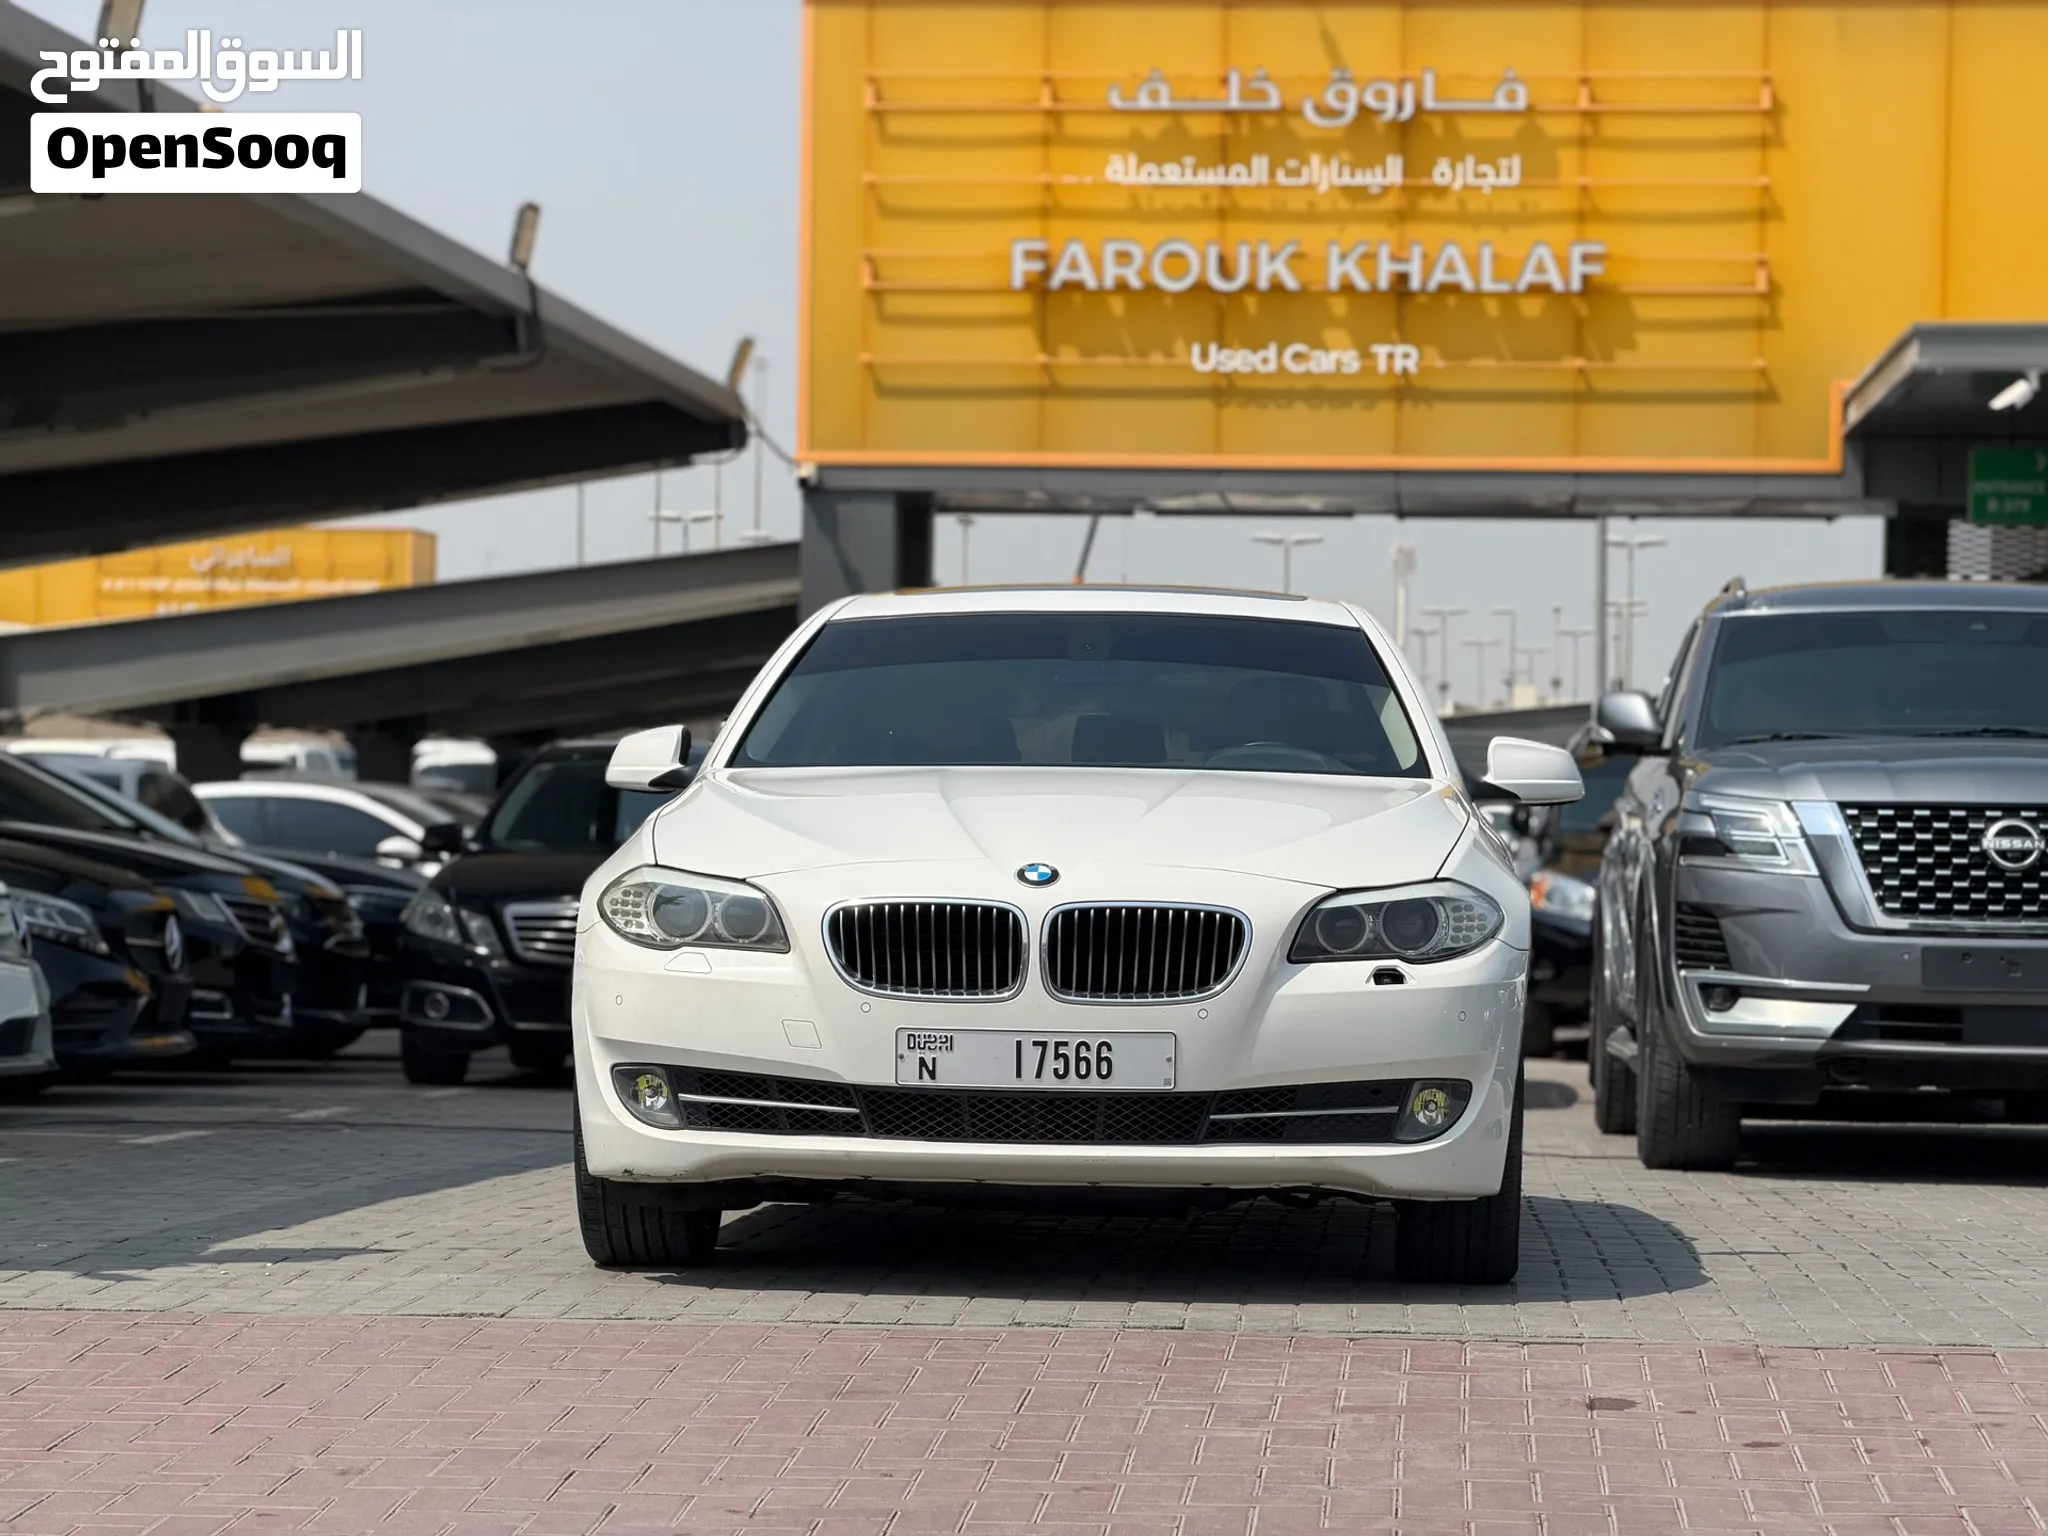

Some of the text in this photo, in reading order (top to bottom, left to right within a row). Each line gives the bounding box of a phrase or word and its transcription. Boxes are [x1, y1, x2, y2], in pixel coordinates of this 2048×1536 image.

[1010, 239, 1607, 294] FAROUK KHALAF
[1190, 342, 1420, 376] Used Cars TR
[1982, 838, 2046, 850] NISSAN
[918, 1056, 937, 1081] N
[1015, 1039, 1114, 1081] 17566
